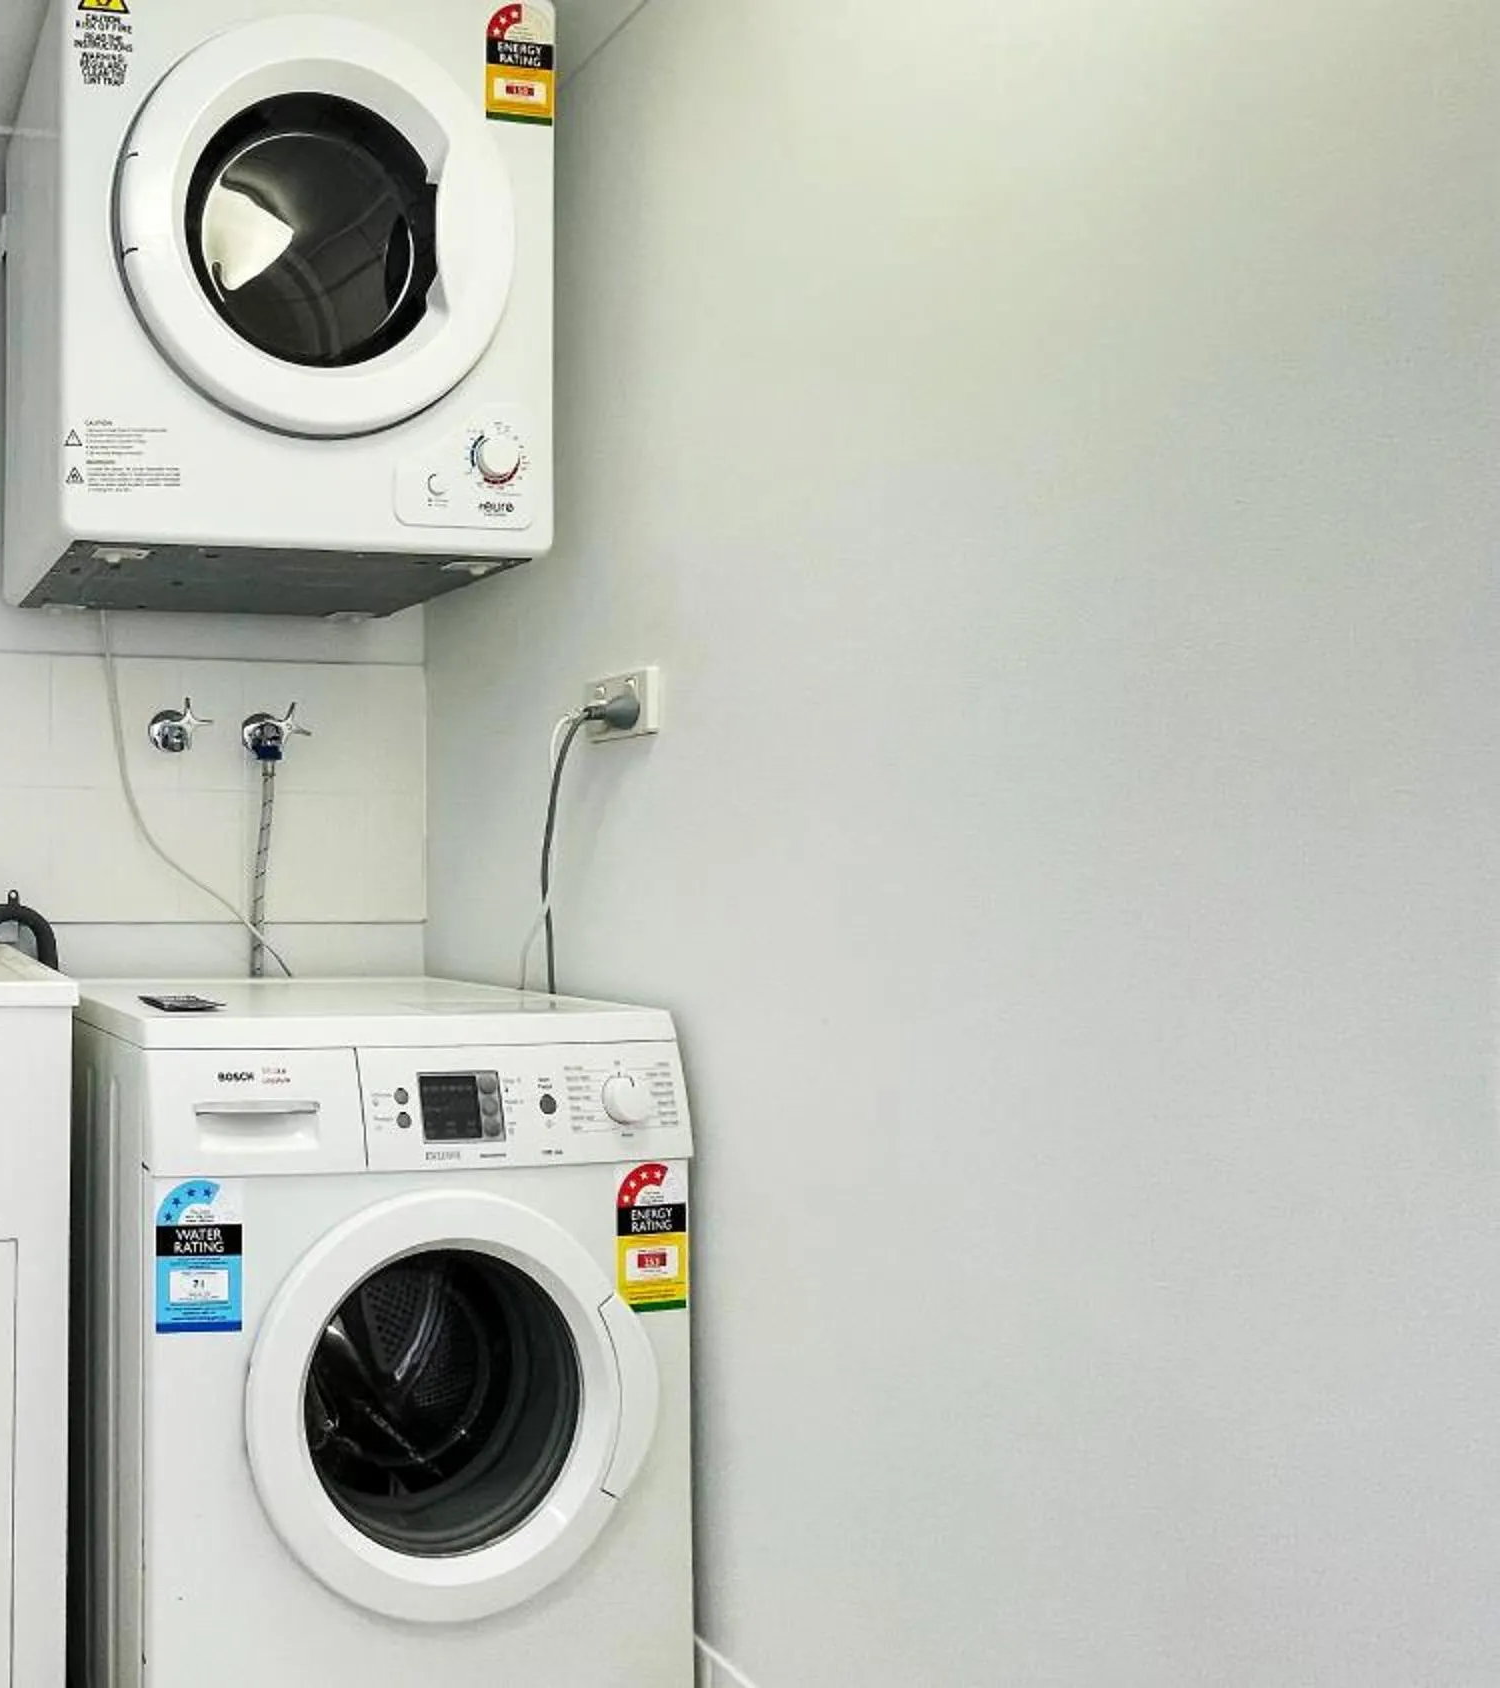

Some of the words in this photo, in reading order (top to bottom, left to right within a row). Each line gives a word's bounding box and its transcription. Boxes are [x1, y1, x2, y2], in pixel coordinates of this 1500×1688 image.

[497, 42, 542, 55] ENERGY
[499, 53, 541, 67] RATING
[217, 1071, 255, 1083] BOSCH
[631, 1208, 673, 1221] ENERGY
[631, 1220, 673, 1233] RATING
[175, 1228, 222, 1241] WATER
[173, 1241, 225, 1254] RATING
